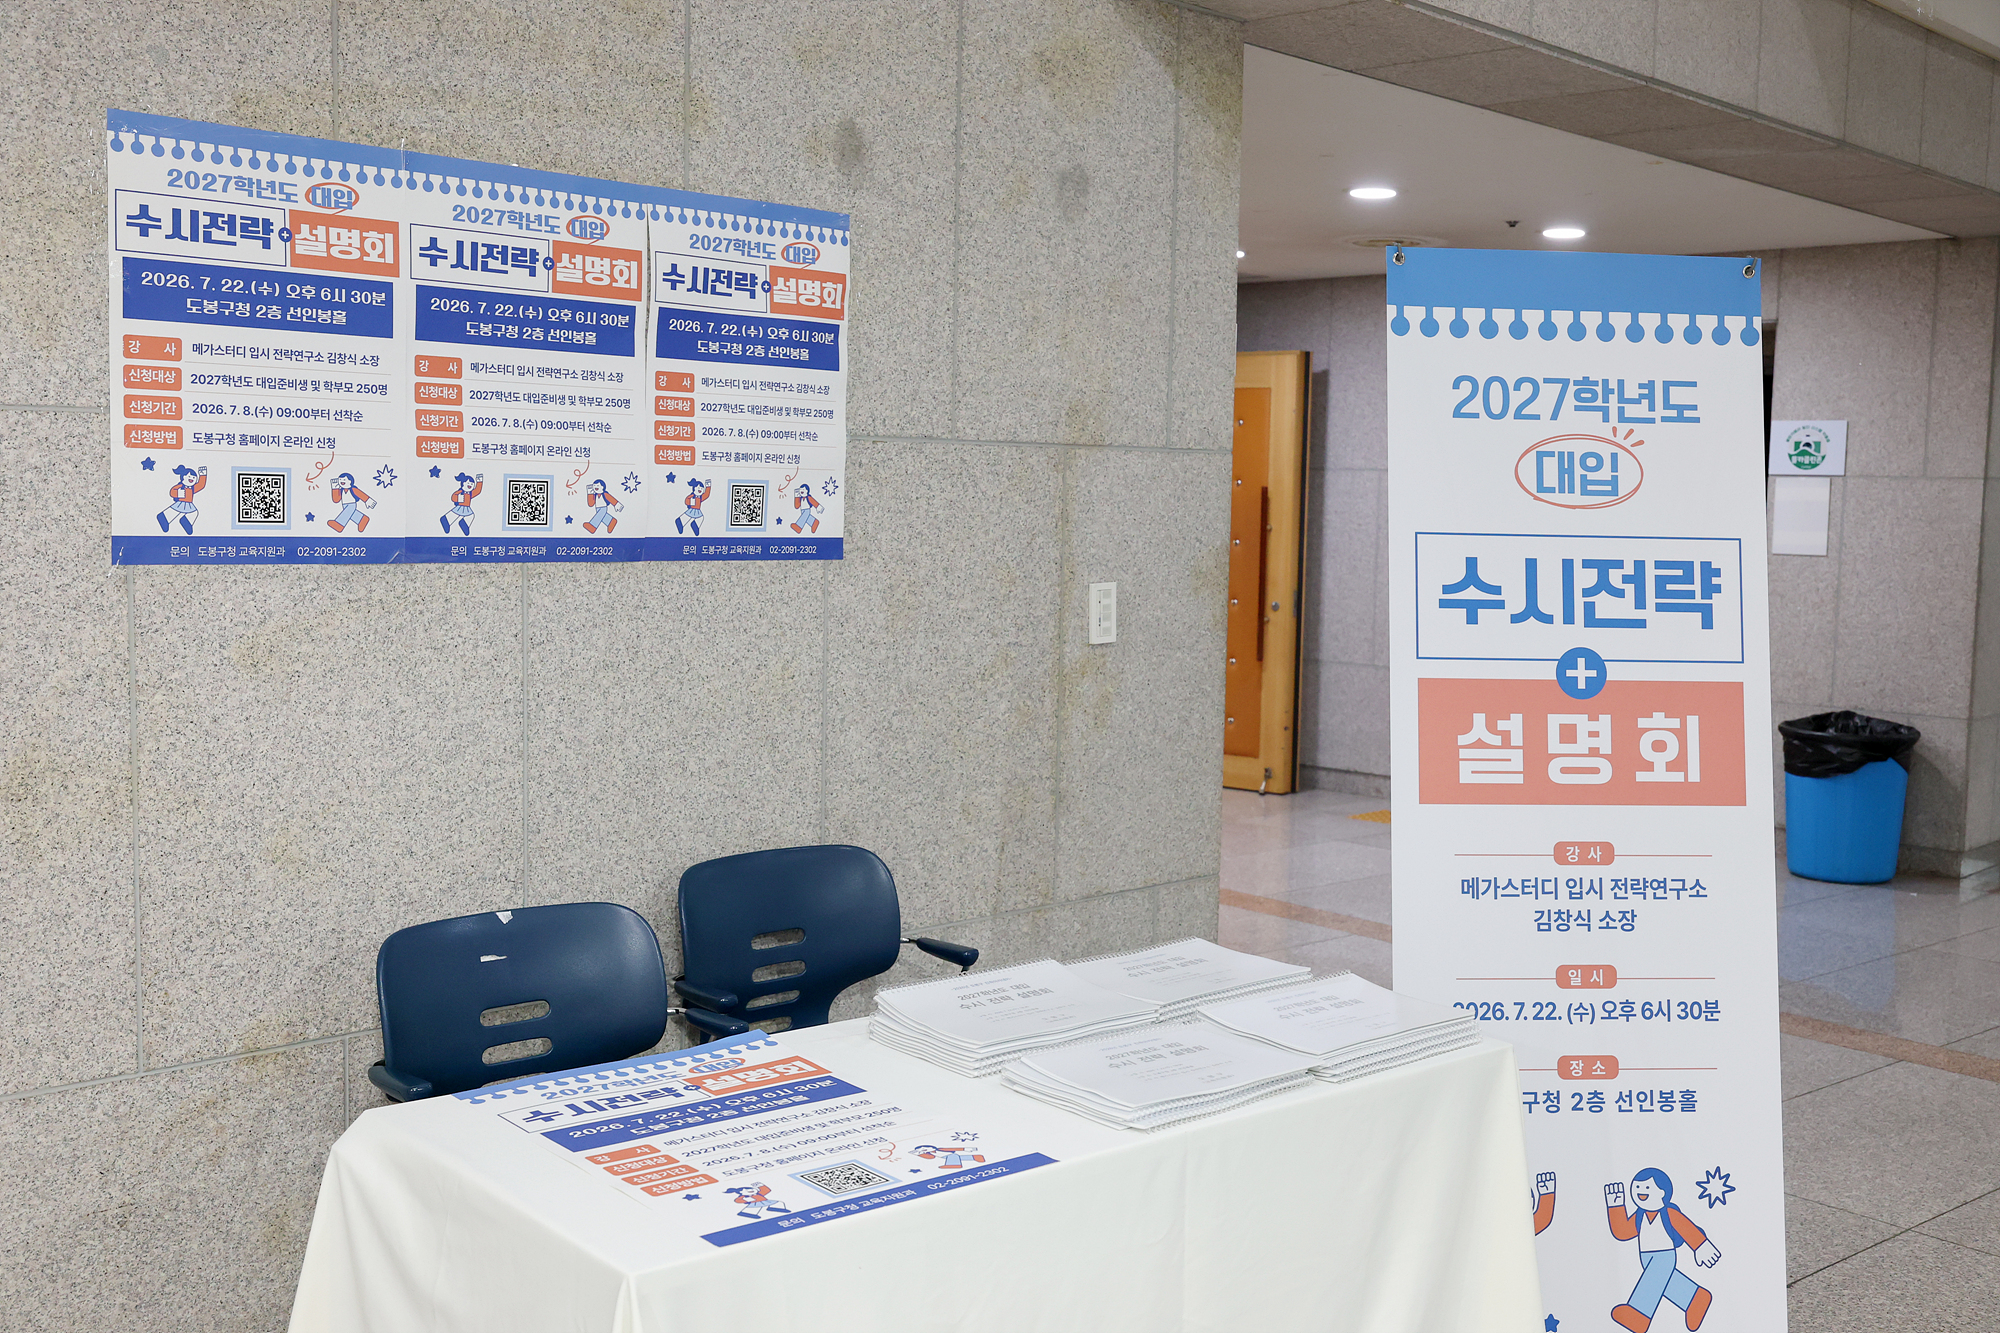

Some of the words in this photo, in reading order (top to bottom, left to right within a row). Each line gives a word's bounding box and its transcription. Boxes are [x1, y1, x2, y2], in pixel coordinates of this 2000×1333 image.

[167, 169, 298, 203] 2027학년도
[311, 186, 353, 210] 대입
[126, 203, 274, 250] 수시전략
[295, 223, 394, 264] 설명회
[452, 204, 561, 235] 2027학년도
[571, 219, 604, 240] 대입
[689, 234, 776, 260] 2027학년도
[785, 245, 816, 265] 대입
[419, 237, 539, 277] 수시전략
[556, 253, 638, 290] 설명회
[141, 271, 195, 290] 2026.
[200, 276, 216, 291] 7.
[221, 278, 280, 297] 22.(수)
[286, 283, 316, 300] 오후
[320, 287, 346, 303] 6시
[350, 290, 386, 307] 30분
[662, 263, 758, 299] 수시전략
[773, 277, 843, 309] 설명회
[186, 298, 251, 317] 도봉구청
[255, 304, 282, 320] 2층
[286, 306, 347, 325] 선인봉홀
[430, 298, 473, 314] 2026.
[478, 302, 490, 315] 7.
[495, 304, 543, 320] 22.(수)
[547, 308, 572, 322] 오후
[576, 311, 597, 325] 6시
[600, 313, 629, 328] 30분
[466, 321, 519, 340] 도봉구청
[522, 326, 544, 340] 2층
[547, 328, 597, 345] 선인봉홀
[669, 318, 704, 333] 2026.
[706, 322, 718, 334] 7.
[721, 323, 763, 338] 22.(수)
[767, 327, 789, 340] 오후
[792, 329, 809, 342] 6시
[811, 331, 834, 345] 30분
[192, 343, 246, 359] 메가스터디
[249, 346, 271, 360] 입시
[273, 347, 324, 363] 전략연구소
[327, 352, 357, 366] 김창식
[360, 353, 380, 367] 소장
[697, 340, 742, 355] 도봉구청
[746, 344, 765, 357] 2층
[768, 345, 810, 360] 선인봉홀
[128, 368, 176, 384] 신청대상
[190, 373, 254, 388] 2027학년도
[256, 377, 308, 393] 대입준비생
[310, 381, 320, 393] 및
[323, 381, 354, 394] 학부모
[357, 383, 388, 396] 250명
[470, 362, 515, 376] 메가스터디
[517, 365, 534, 378] 입시
[536, 366, 579, 380] 전략연구소
[581, 370, 606, 382] 김창식
[607, 372, 624, 383] 소장
[419, 385, 457, 399] 신청대상
[469, 390, 521, 403] 2027학년도
[523, 392, 567, 406] 대입준비생
[568, 396, 576, 406] 및
[578, 395, 604, 407] 학부모
[605, 397, 631, 409] 250명
[658, 399, 691, 412] 신청대상
[1452, 375, 1701, 424] 2027학년도
[129, 400, 176, 415] 신청기간
[192, 403, 227, 416] 2026.
[229, 405, 240, 417] 7.
[276, 407, 331, 421] 09:00부터
[333, 409, 364, 422] 선착순
[420, 413, 459, 428] 신청기간
[471, 416, 500, 428] 2026.
[502, 419, 511, 428] 7.
[541, 419, 585, 432] 09:00부터
[587, 421, 612, 433] 선착순
[129, 429, 177, 445] 신청방법
[192, 432, 237, 446] 도봉구청
[238, 434, 281, 447] 홈페이지
[282, 435, 314, 448] 온라인
[316, 437, 336, 449] 신청
[658, 425, 691, 437] 신청기간
[421, 441, 459, 454] 신청방법
[472, 443, 508, 455] 도봉구청
[509, 444, 544, 456] 홈페이지
[546, 445, 573, 457] 온라인
[574, 446, 591, 458] 신청
[658, 449, 691, 461] 신청방법
[1535, 450, 1619, 497] 대입
[170, 546, 190, 558] 문의
[197, 546, 237, 558] 도봉구청
[238, 546, 285, 558] 교육지원과
[297, 546, 366, 557] 02-2091-2302
[451, 545, 467, 556] 문의
[473, 545, 506, 556] 도봉구청
[507, 545, 547, 557] 교육지원과
[556, 546, 613, 556] 02-2091-2302
[682, 545, 697, 555] 문의
[701, 545, 729, 555] 도봉구청
[729, 545, 762, 555] 교육지원과
[769, 546, 817, 554] 02-2091-2302
[1438, 556, 1722, 630] 수시전략
[1461, 877, 1559, 900] 메가스터디
[1565, 877, 1603, 900] 입시
[1609, 877, 1708, 900] 전략연구소
[1533, 909, 1592, 932] 김창식
[1598, 909, 1637, 932] 소장
[1600, 999, 1637, 1022] 오후
[1640, 999, 1671, 1022] 6시
[1676, 999, 1721, 1022] 30분
[522, 1085, 685, 1123] 수시전략
[700, 1060, 819, 1091] 설명회
[540, 1071, 687, 1100] 2027학년도
[692, 1058, 739, 1074] 대입
[724, 1093, 761, 1107] 오후
[766, 1086, 793, 1100] 6시
[795, 1079, 838, 1093] 30분
[1522, 1089, 1562, 1114] 구청
[1570, 1089, 1606, 1113] 2층
[1614, 1089, 1698, 1114] 선인봉홀
[630, 1115, 705, 1136] 도봉구청
[707, 1109, 740, 1120] 2층
[739, 1095, 811, 1114] 선인봉홀
